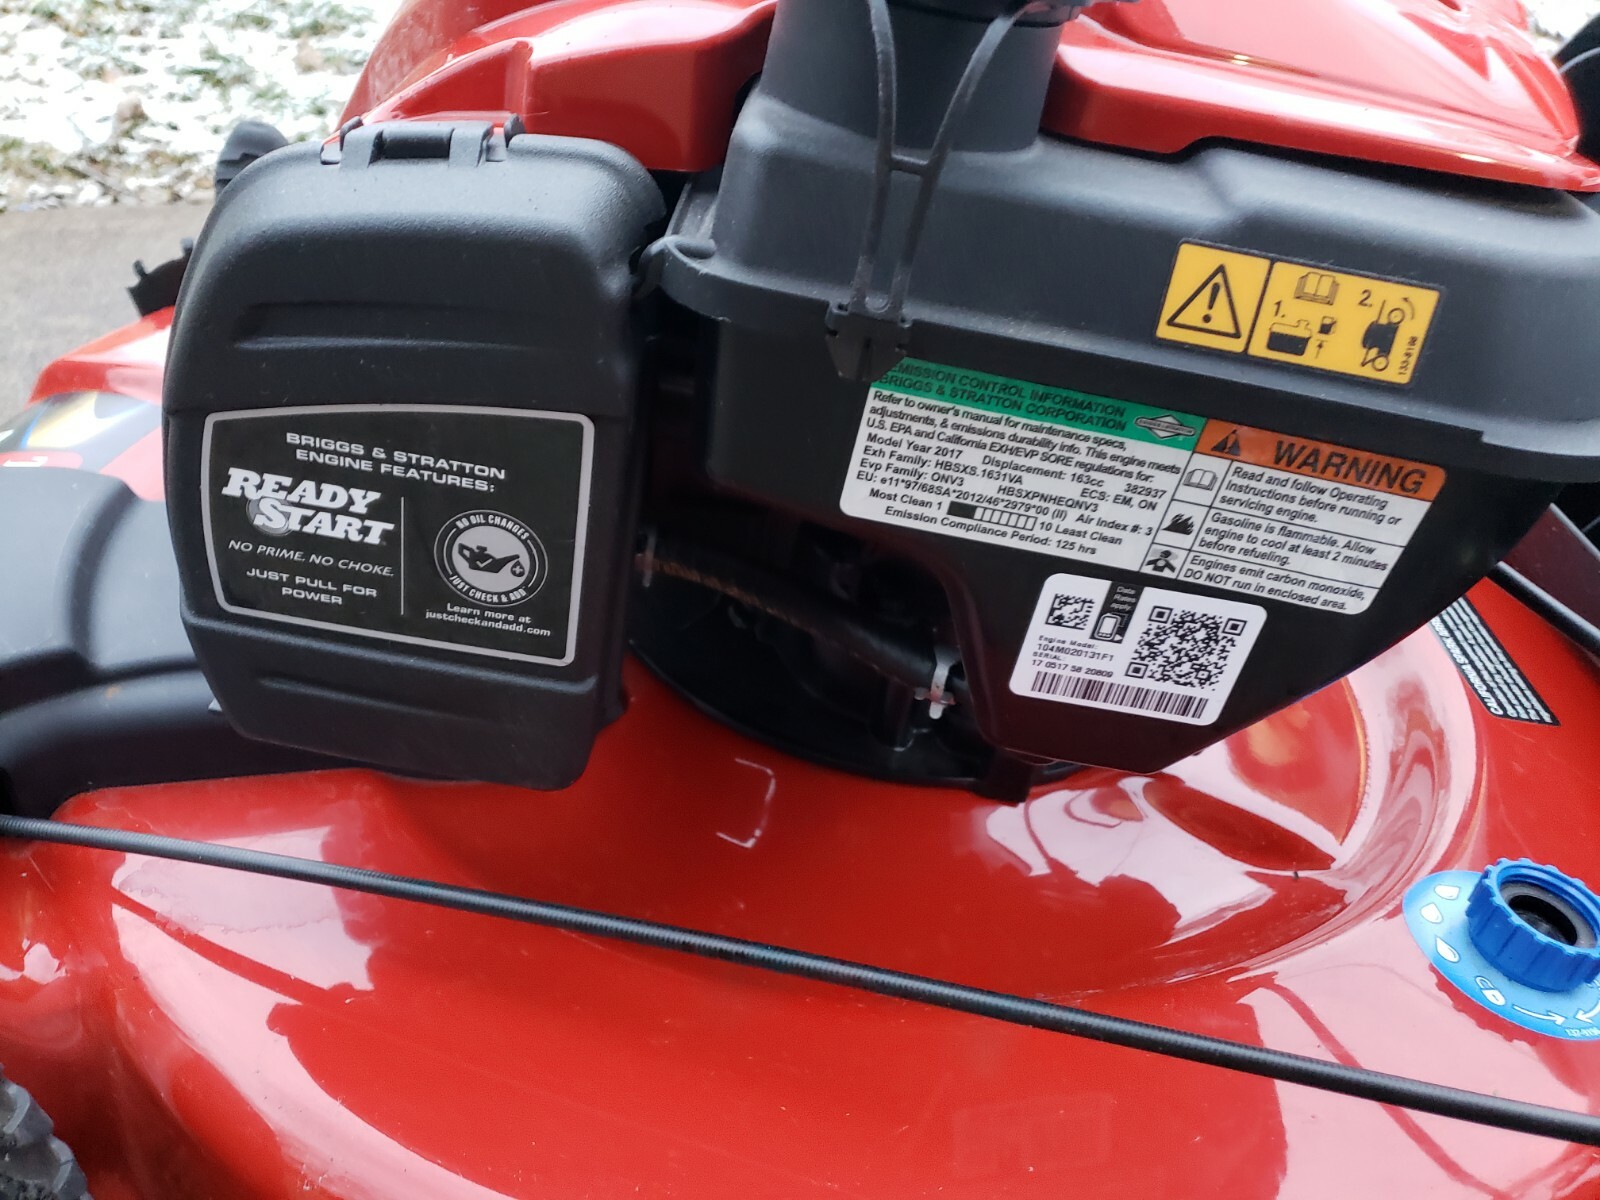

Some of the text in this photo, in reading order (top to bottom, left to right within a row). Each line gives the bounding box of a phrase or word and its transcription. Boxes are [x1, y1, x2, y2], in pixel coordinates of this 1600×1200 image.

[1273, 300, 1286, 318] 1.
[1358, 289, 1373, 307] 2.
[878, 371, 933, 393] BRIGGS
[935, 384, 945, 396] &
[948, 386, 1024, 411] STRATTON
[1025, 402, 1127, 431] CORPORATION
[957, 374, 1026, 399] CONTROL
[1029, 389, 1126, 418] INFORMATION
[872, 389, 1127, 452] Refer to owner's manual for maintenance specs,
[866, 431, 963, 459] Model Year 2017
[866, 416, 887, 431] U.S.
[889, 421, 912, 436] EPA
[913, 428, 936, 440] and
[936, 430, 987, 450] California
[988, 441, 1039, 459] EXH/EVP
[1039, 451, 1074, 467] SORE
[1073, 460, 1134, 479] regulations
[868, 405, 1181, 475] adjustments, & emissions durability info. This engine meets
[286, 432, 505, 480] BRIGGS & STRATTON
[295, 448, 494, 492] ENGINE FEATURES:
[862, 444, 1023, 485] Exh Family: HBSXS.1631VA
[981, 454, 1104, 488] Displacement: 163cc
[1272, 439, 1427, 494] WARNING
[855, 469, 877, 483] EU:
[859, 457, 964, 487] Evp Family: ONV3
[221, 466, 381, 514] READY
[868, 487, 943, 510] Most Clean 1
[1079, 487, 1158, 511] ECS: EM, ON
[1123, 482, 1167, 499] 382937
[1224, 479, 1402, 525] Instructions before running or
[1231, 465, 1389, 511] Read and follow Operating
[253, 498, 395, 546] START
[1218, 494, 1317, 523] servicing engine.
[455, 517, 470, 530] NO
[488, 514, 530, 541] CHANGES
[884, 505, 1097, 555] Emission Compliance Period: 125 hrs
[1039, 521, 1123, 545] 10 Least Clean
[1074, 513, 1153, 536] Air Index #: 3
[1210, 511, 1376, 555] Gasoline is flammable. Allow
[228, 539, 394, 577] NO PRIME. NO CHOKE.
[1197, 537, 1290, 567] before refueling.
[1200, 526, 1388, 571] engine to cool at least 2 minutes
[246, 567, 377, 597] JUST PULL FOR
[449, 573, 468, 592] JUST
[468, 588, 500, 603] CHECK
[1182, 567, 1347, 610] DO NOT run in enclosed area.
[1189, 554, 1365, 601] Engines emit carbon monoxide,
[281, 586, 342, 605] POWER
[425, 609, 551, 636] justcheckandadd.com
[446, 602, 531, 624] Learn more at
[1037, 643, 1114, 662] 104M020131F1
[1038, 634, 1067, 645] Engine
[1032, 659, 1043, 668] 17
[1047, 661, 1070, 672] 0517
